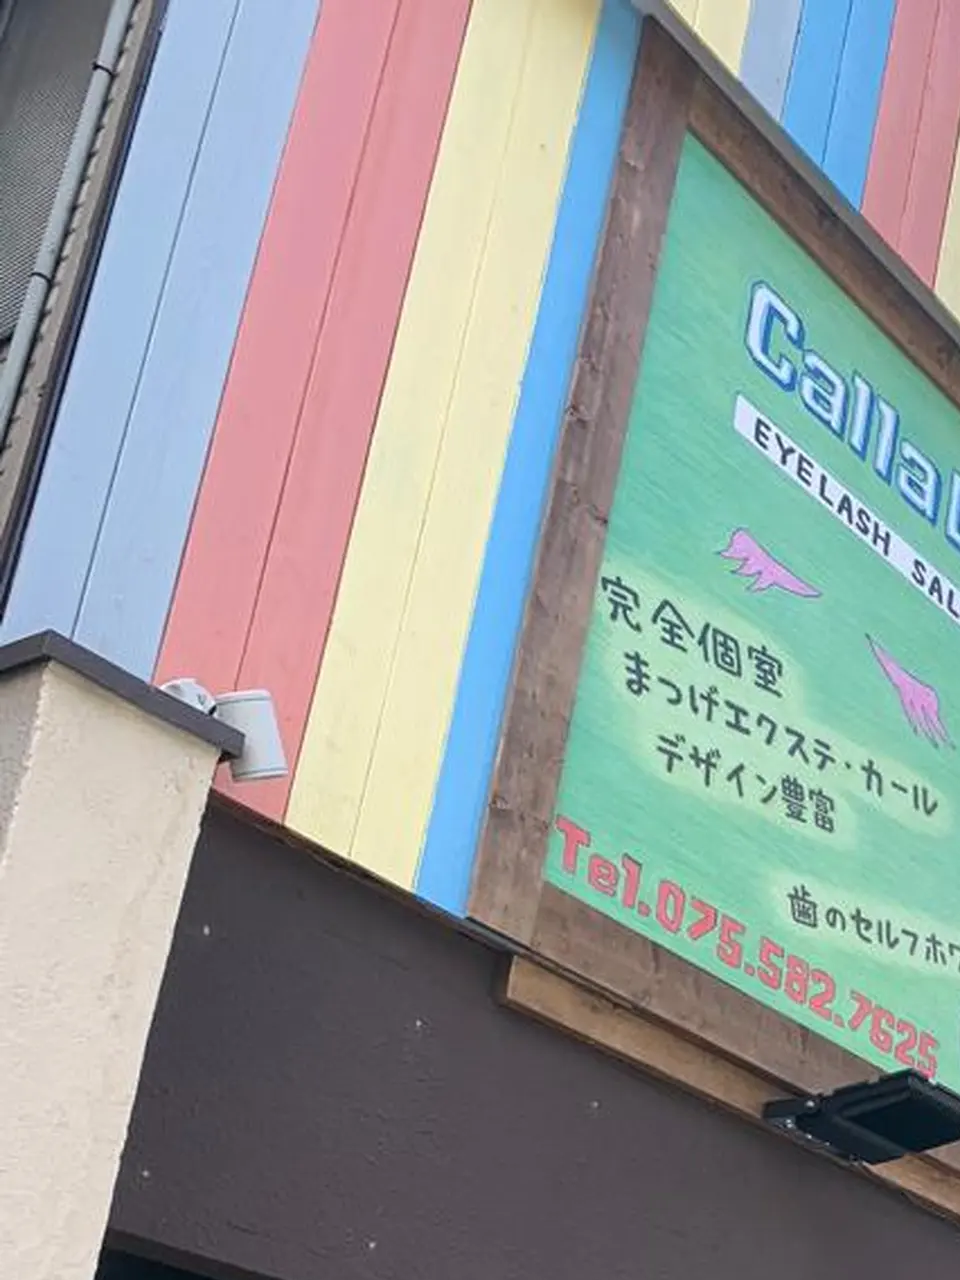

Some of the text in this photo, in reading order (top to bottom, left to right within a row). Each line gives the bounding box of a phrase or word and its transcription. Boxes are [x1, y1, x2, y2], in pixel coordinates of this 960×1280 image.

[753, 416, 893, 554] EYELASH
[600, 575, 784, 699] 完全個室
[656, 735, 836, 834] デザイン豊富
